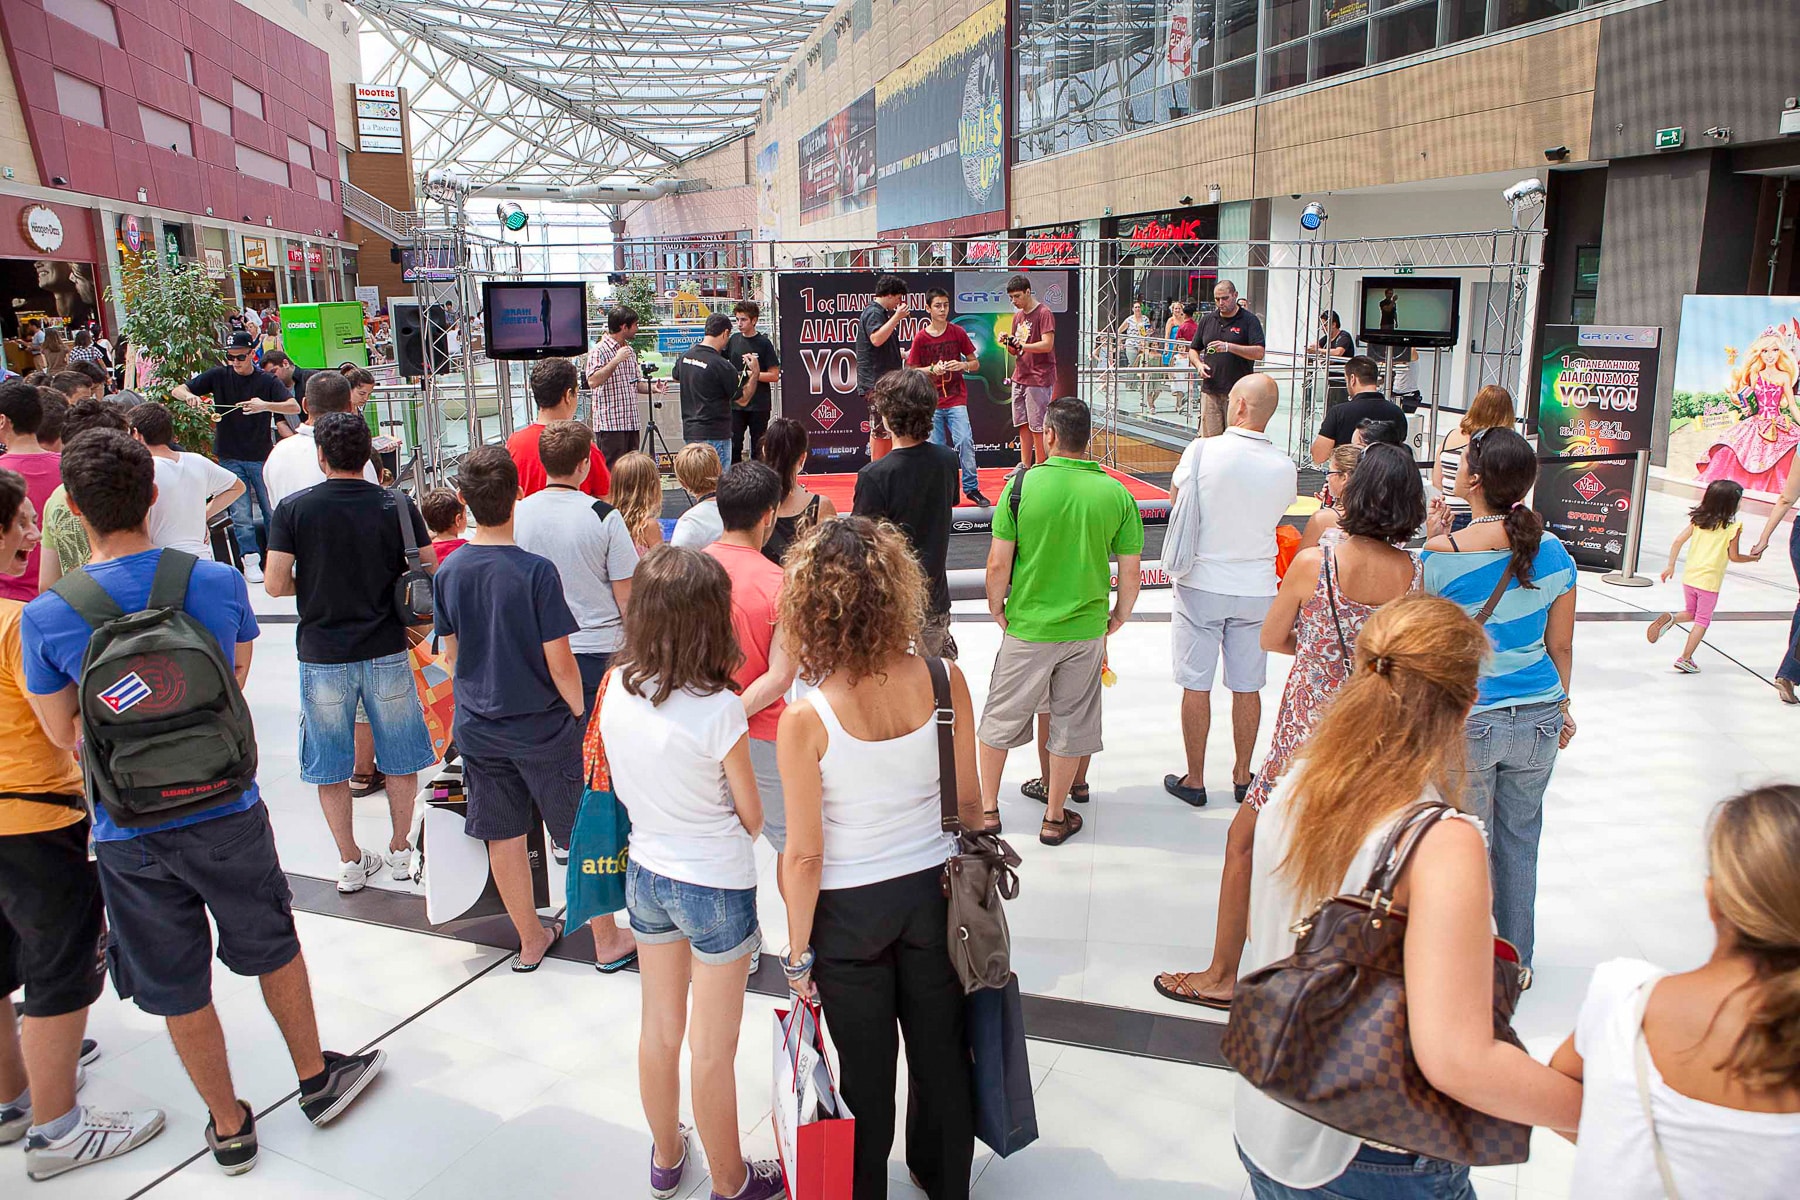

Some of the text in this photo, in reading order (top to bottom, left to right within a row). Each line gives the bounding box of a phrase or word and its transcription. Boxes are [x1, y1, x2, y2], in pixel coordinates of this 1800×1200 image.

[358, 88, 395, 98] HOOTERS
[958, 95, 1002, 157] WHAT'S
[980, 152, 1001, 190] UP?
[1559, 371, 1639, 386] ΔΙΑΓΩΝΙΣΜΟΣ
[1559, 385, 1639, 412] YO-YO!
[817, 409, 837, 419] Mall
[1579, 481, 1599, 492] Mall
[1139, 508, 1167, 519] ORTY
[1567, 511, 1607, 523] SPORTY
[161, 788, 195, 798] ELEMENT
[196, 784, 212, 793] FOR
